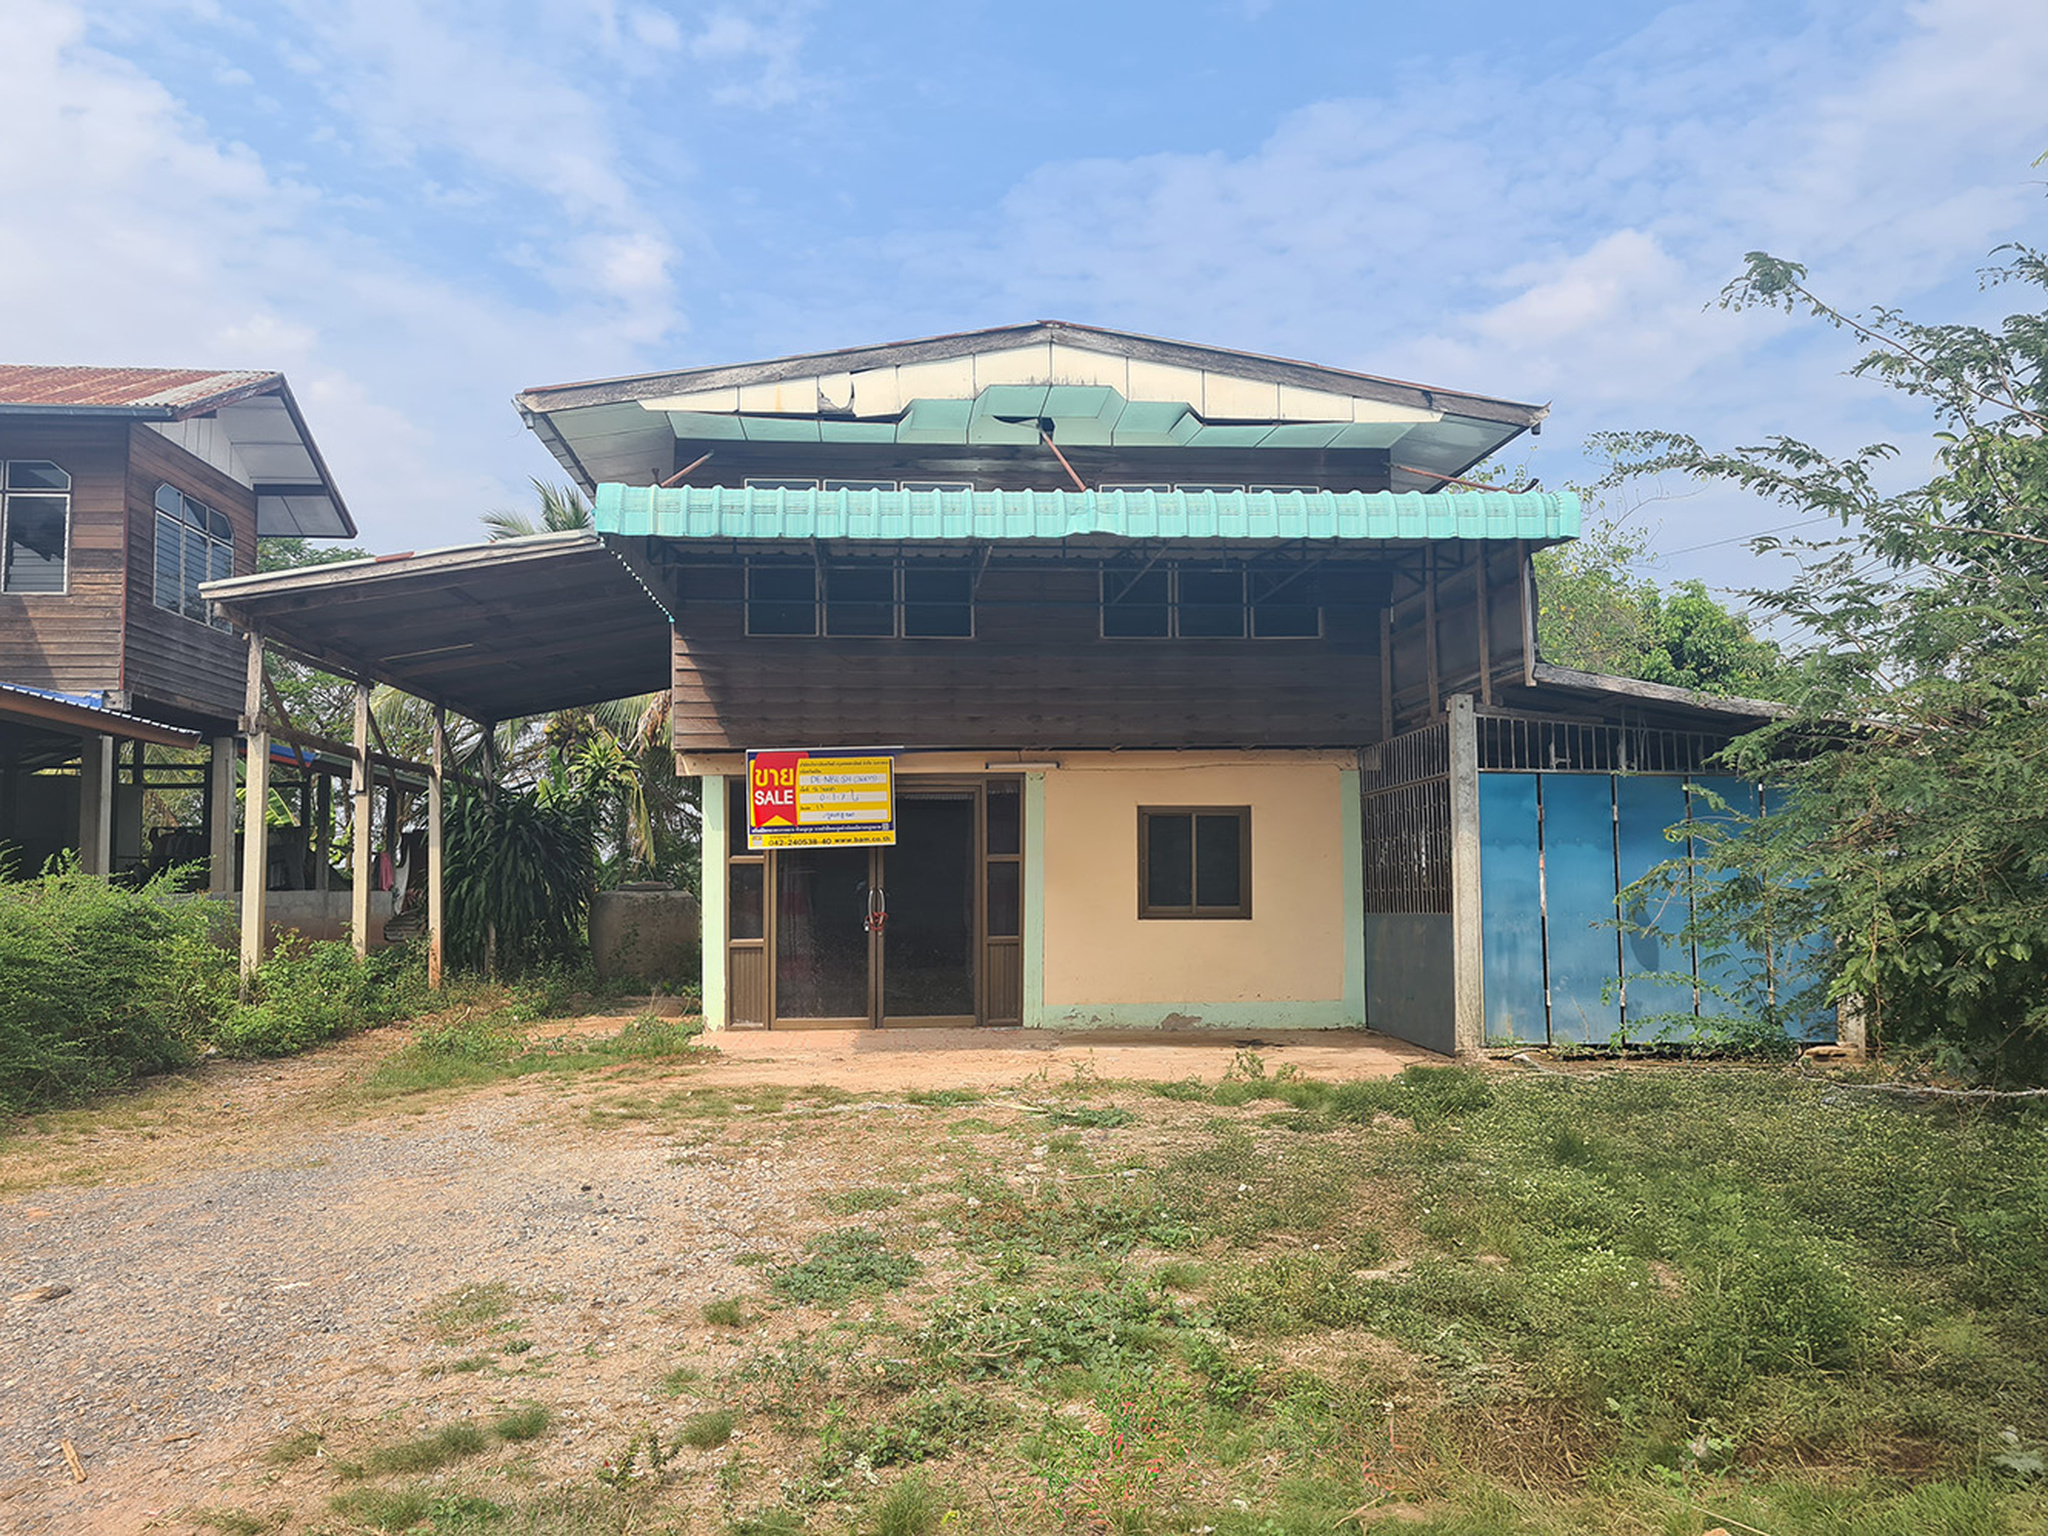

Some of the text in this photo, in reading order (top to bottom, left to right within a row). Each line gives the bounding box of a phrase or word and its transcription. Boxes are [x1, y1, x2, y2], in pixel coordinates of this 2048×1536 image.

[755, 768, 794, 787] ขาย
[754, 789, 794, 806] SALE
[835, 836, 891, 844] www.bam.co.th
